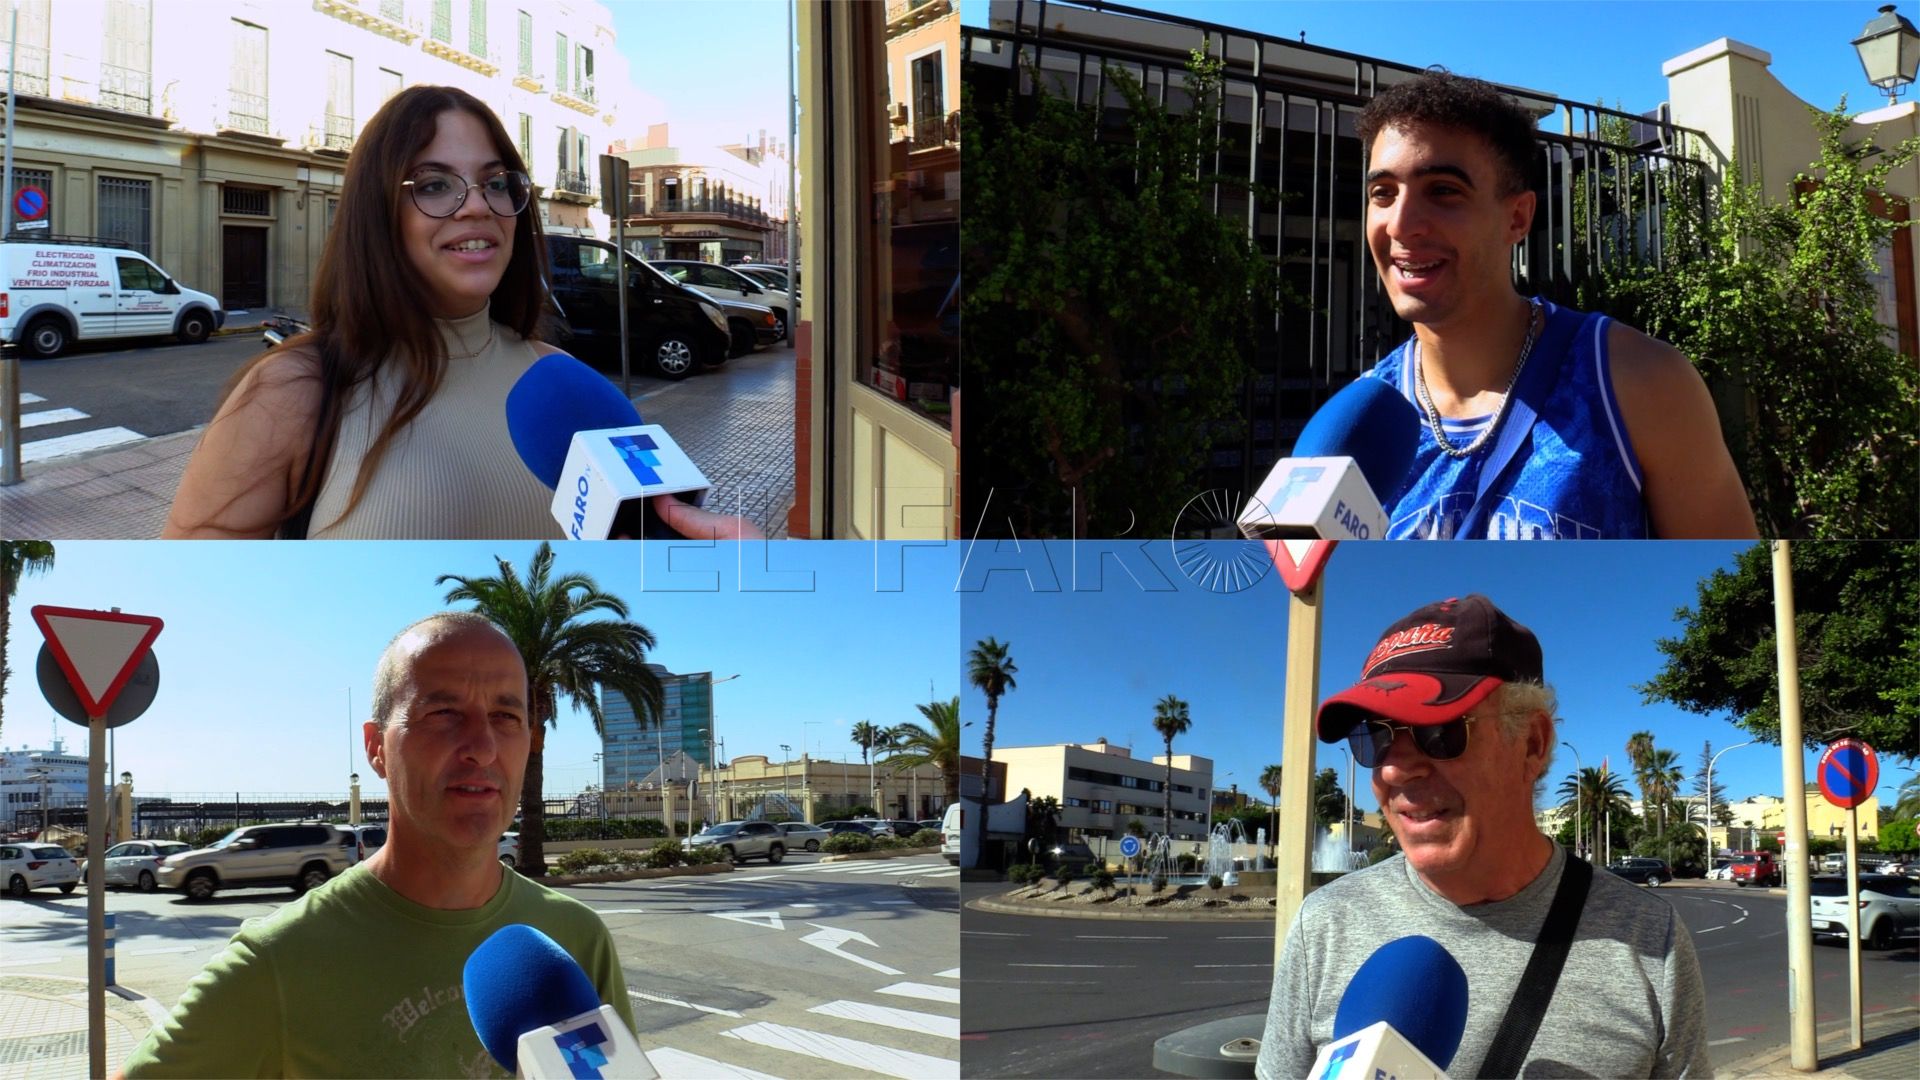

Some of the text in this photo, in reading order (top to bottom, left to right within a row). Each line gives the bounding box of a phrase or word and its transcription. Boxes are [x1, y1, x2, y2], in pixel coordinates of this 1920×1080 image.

[35, 250, 95, 260] ELECTRICIDAD
[32, 260, 97, 269] CLIMATIZACION
[27, 269, 99, 278] FRIO INDUSTRIAL
[12, 278, 111, 287] VENTILACION FORZADA
[571, 475, 589, 540] FARO
[1333, 499, 1370, 540] FARO
